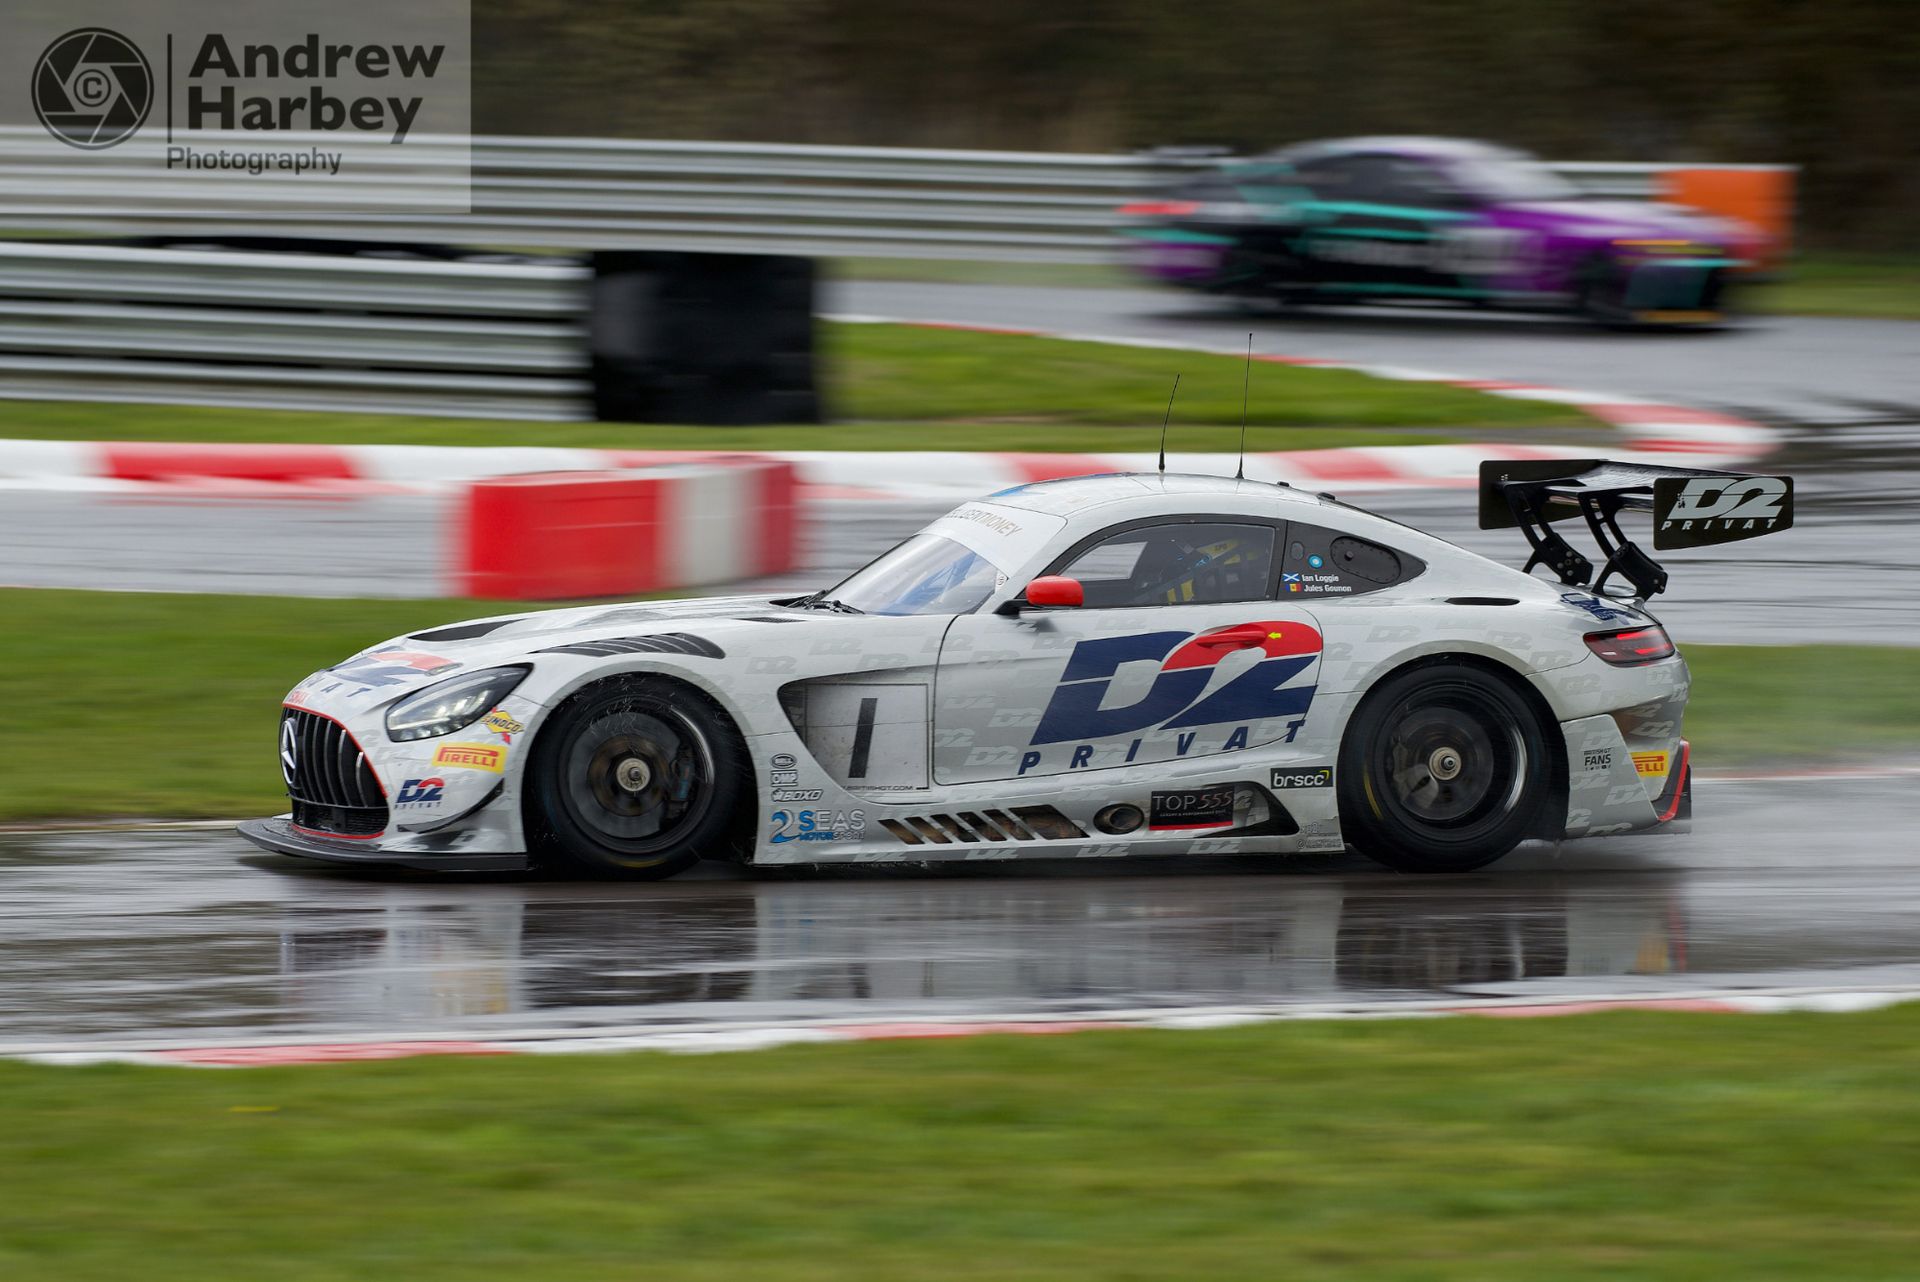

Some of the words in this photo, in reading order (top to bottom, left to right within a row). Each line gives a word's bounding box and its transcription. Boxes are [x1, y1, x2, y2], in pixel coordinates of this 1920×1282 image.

[1667, 478, 1788, 519] D2
[1661, 517, 1777, 531] PRIVAT
[1301, 574, 1314, 582] Ian
[1314, 574, 1339, 583] Loggie
[1029, 621, 1323, 745] D2
[483, 715, 521, 732] SUNOCO
[437, 747, 499, 767] PIRELLI
[1018, 720, 1305, 775] PRIVAT
[1585, 754, 1611, 766] FANS
[1273, 772, 1325, 786] brscc
[396, 777, 445, 803] D2
[784, 790, 822, 801] BOXO
[1152, 795, 1197, 810] TOP
[1197, 790, 1234, 810] 555
[799, 808, 866, 831] SEAS
